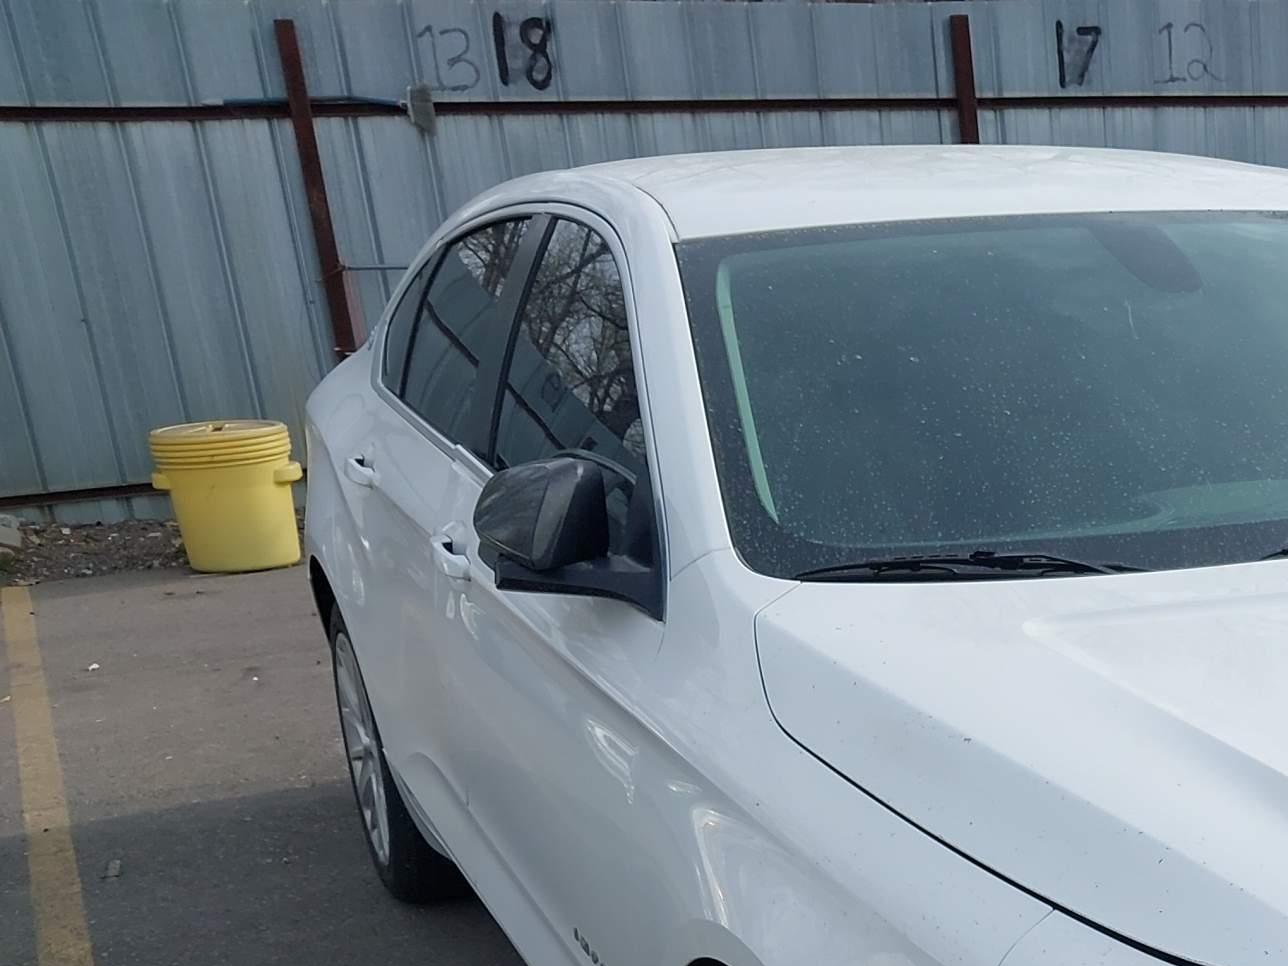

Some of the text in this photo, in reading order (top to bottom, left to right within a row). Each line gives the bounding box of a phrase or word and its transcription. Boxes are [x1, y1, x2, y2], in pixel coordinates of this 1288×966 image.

[416, 24, 480, 91] 13
[493, 12, 553, 91] 18
[1055, 19, 1102, 88] 17
[1152, 22, 1225, 84] 12
